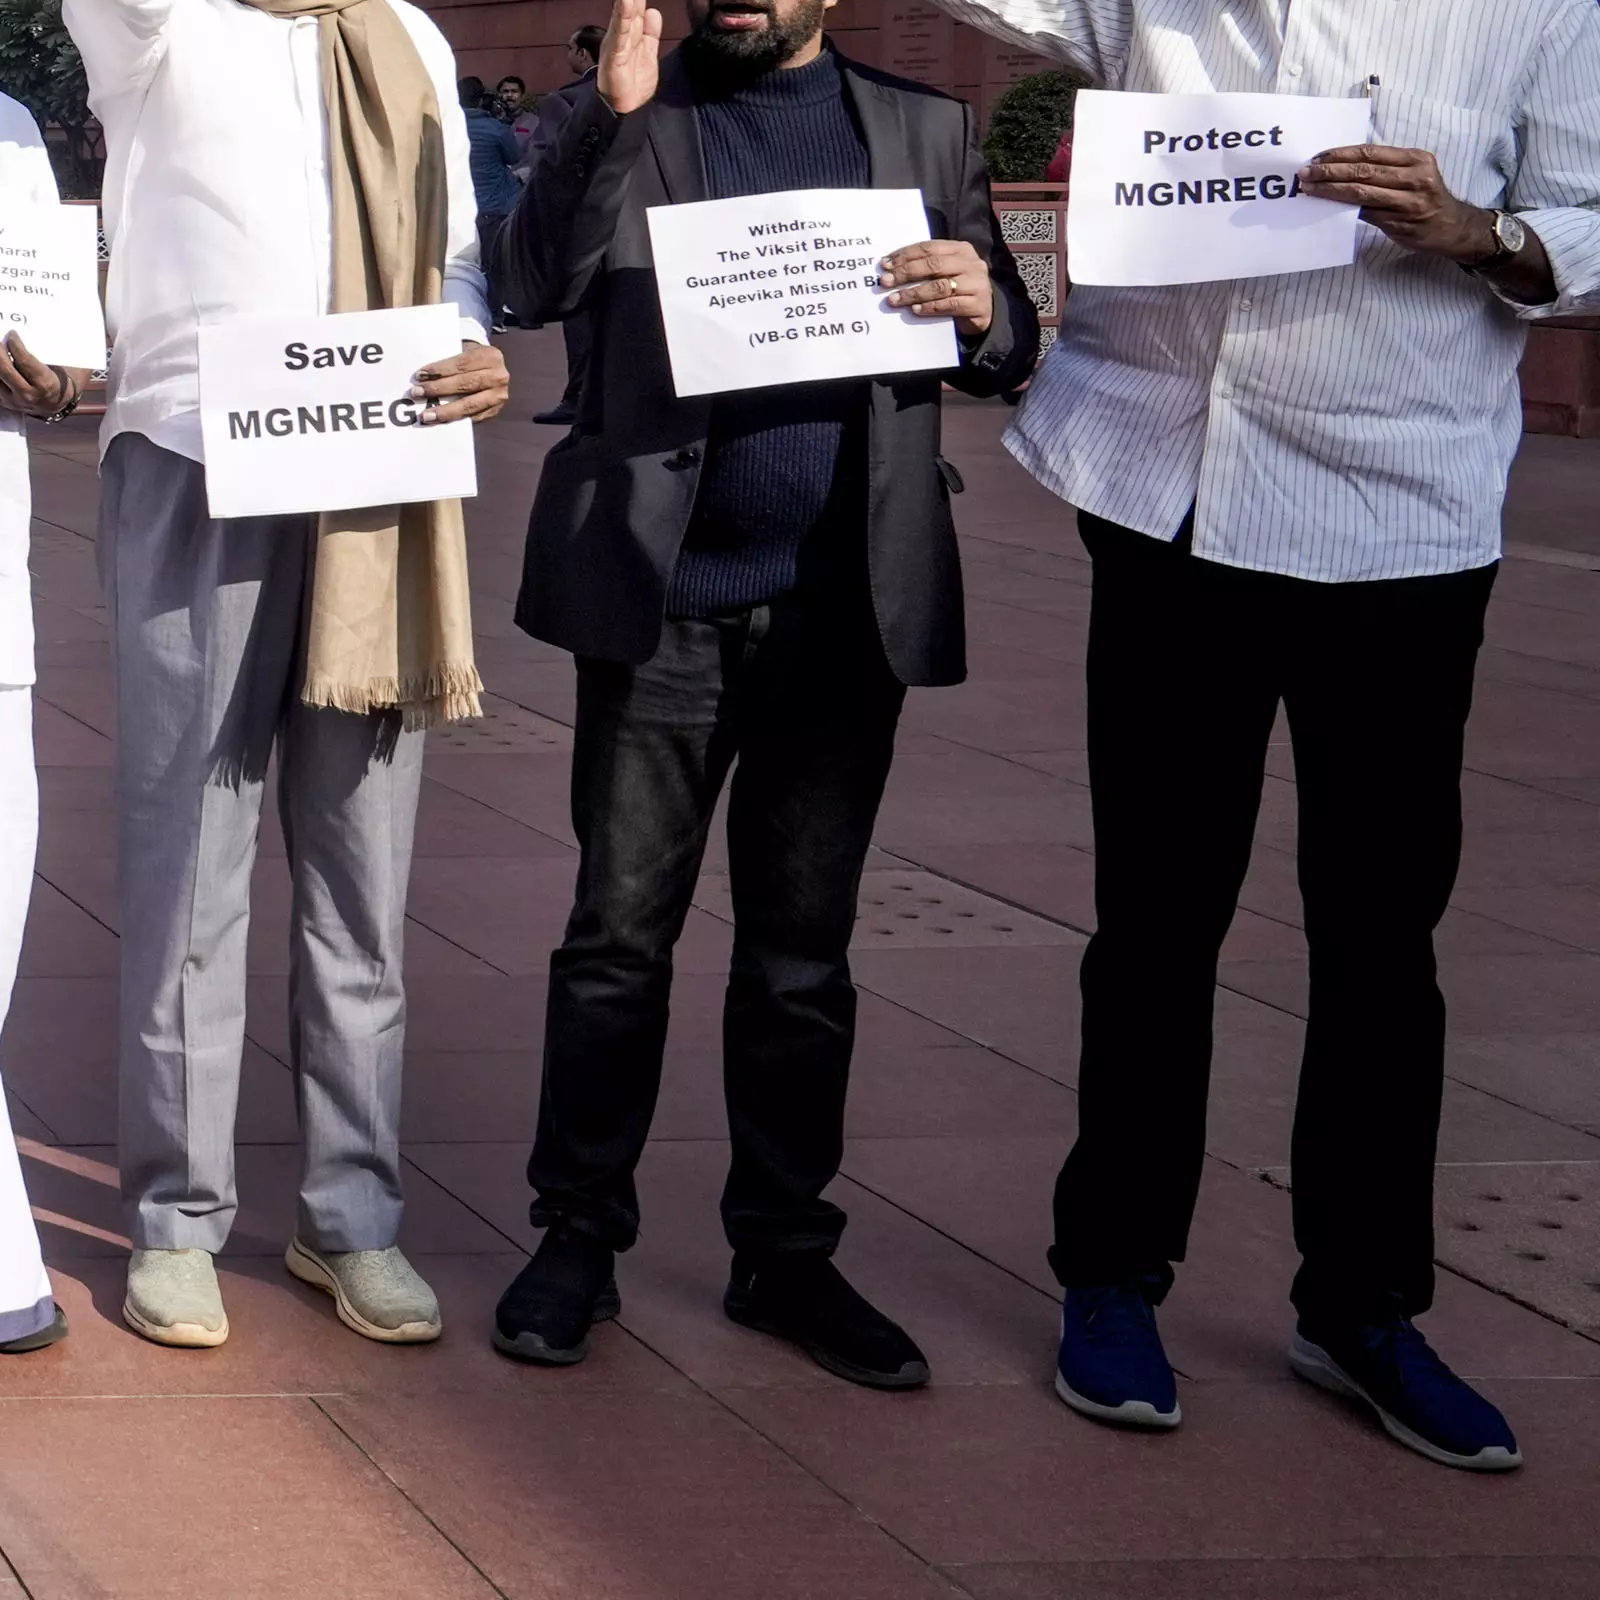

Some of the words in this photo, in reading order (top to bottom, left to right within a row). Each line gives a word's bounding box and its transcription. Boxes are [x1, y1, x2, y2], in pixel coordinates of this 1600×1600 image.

[1144, 126, 1283, 153] Protect
[748, 220, 831, 237] Withdraw
[716, 250, 750, 263] The
[755, 241, 808, 257] Viksit
[813, 237, 871, 250] Bharat
[42, 272, 70, 281] and
[686, 269, 777, 288] Guarantee
[783, 264, 807, 275] for
[813, 257, 874, 272] Rozgar
[709, 289, 783, 308] Ajeevika
[789, 280, 857, 296] Mission
[10, 313, 27, 325] G)
[784, 303, 827, 318] 2025
[749, 328, 798, 348] (VB-G
[805, 323, 844, 338] RAM
[851, 321, 870, 335] G)
[285, 343, 383, 370] Save
